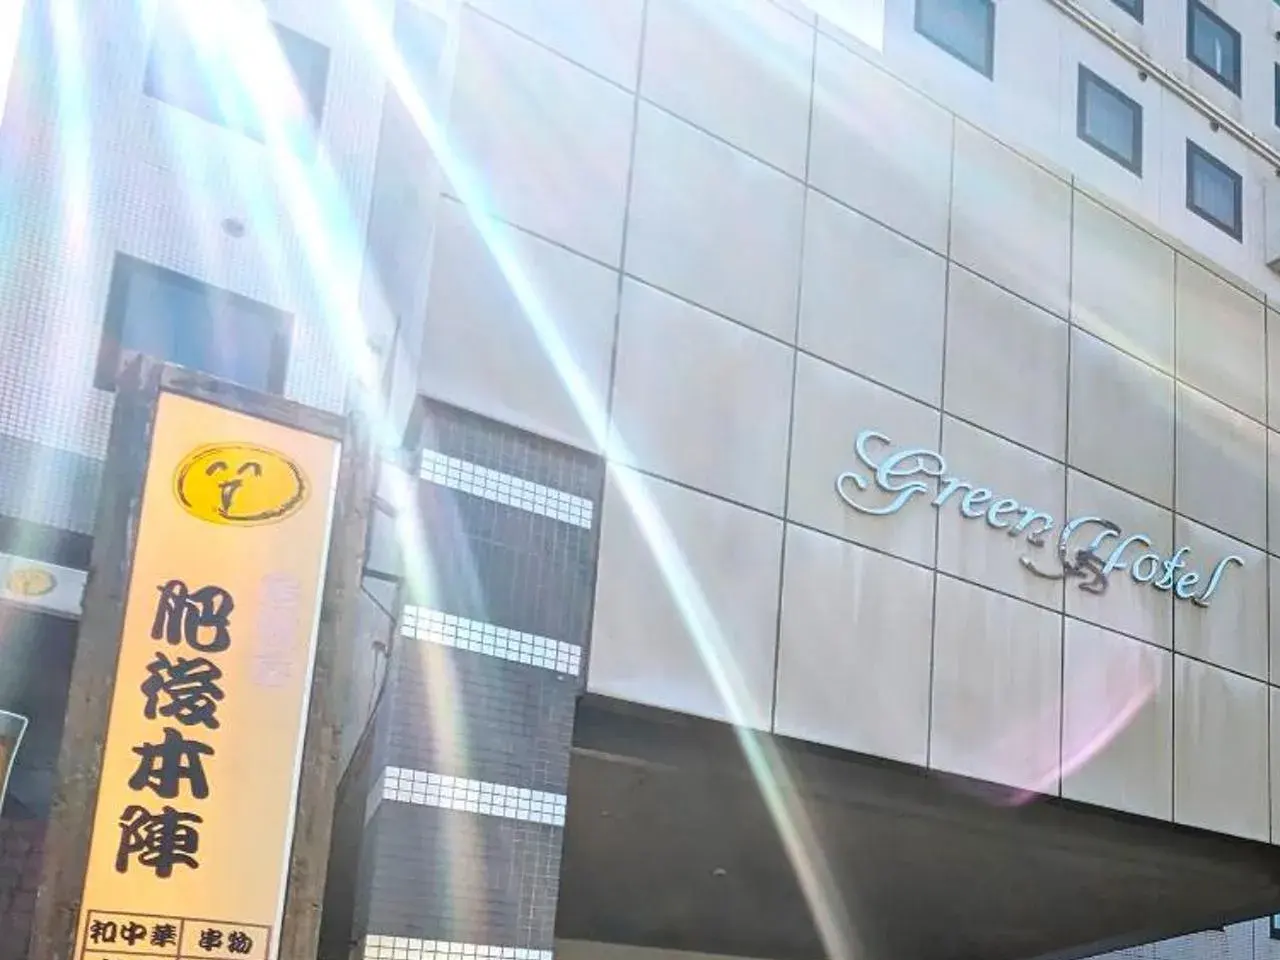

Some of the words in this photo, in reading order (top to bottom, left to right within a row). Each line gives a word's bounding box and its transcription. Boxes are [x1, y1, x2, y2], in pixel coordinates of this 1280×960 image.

[835, 429, 1054, 547] Green
[1018, 515, 1246, 609] Hotel
[114, 578, 236, 879] 肥後本陣
[89, 919, 178, 948] 和中華
[197, 927, 254, 955] 串物
